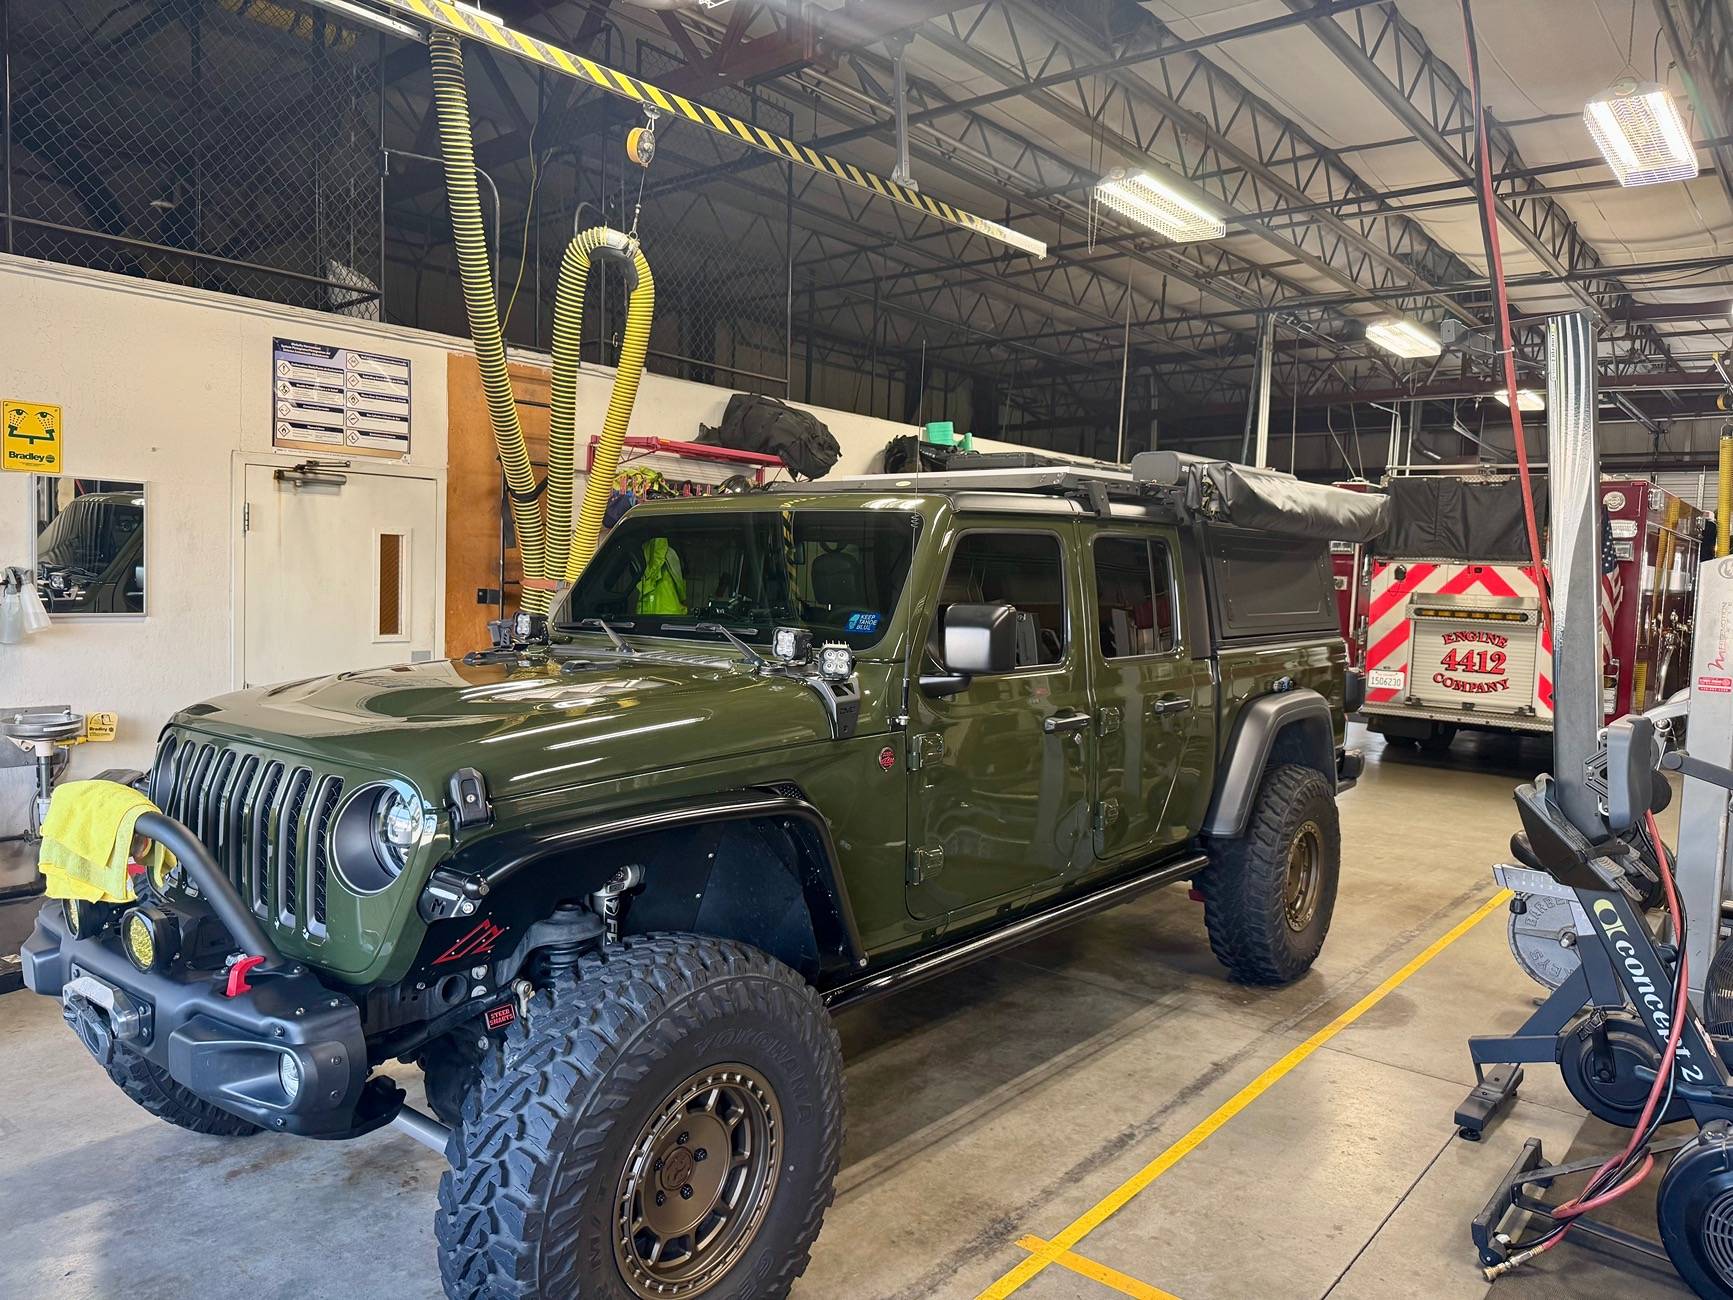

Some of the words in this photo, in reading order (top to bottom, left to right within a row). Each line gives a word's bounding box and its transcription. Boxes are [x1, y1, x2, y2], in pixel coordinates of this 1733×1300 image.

[8, 451, 45, 462] Bradley
[1442, 631, 1509, 649] ENGINE
[1440, 648, 1507, 675] 4412
[1433, 672, 1510, 694] COMPANY
